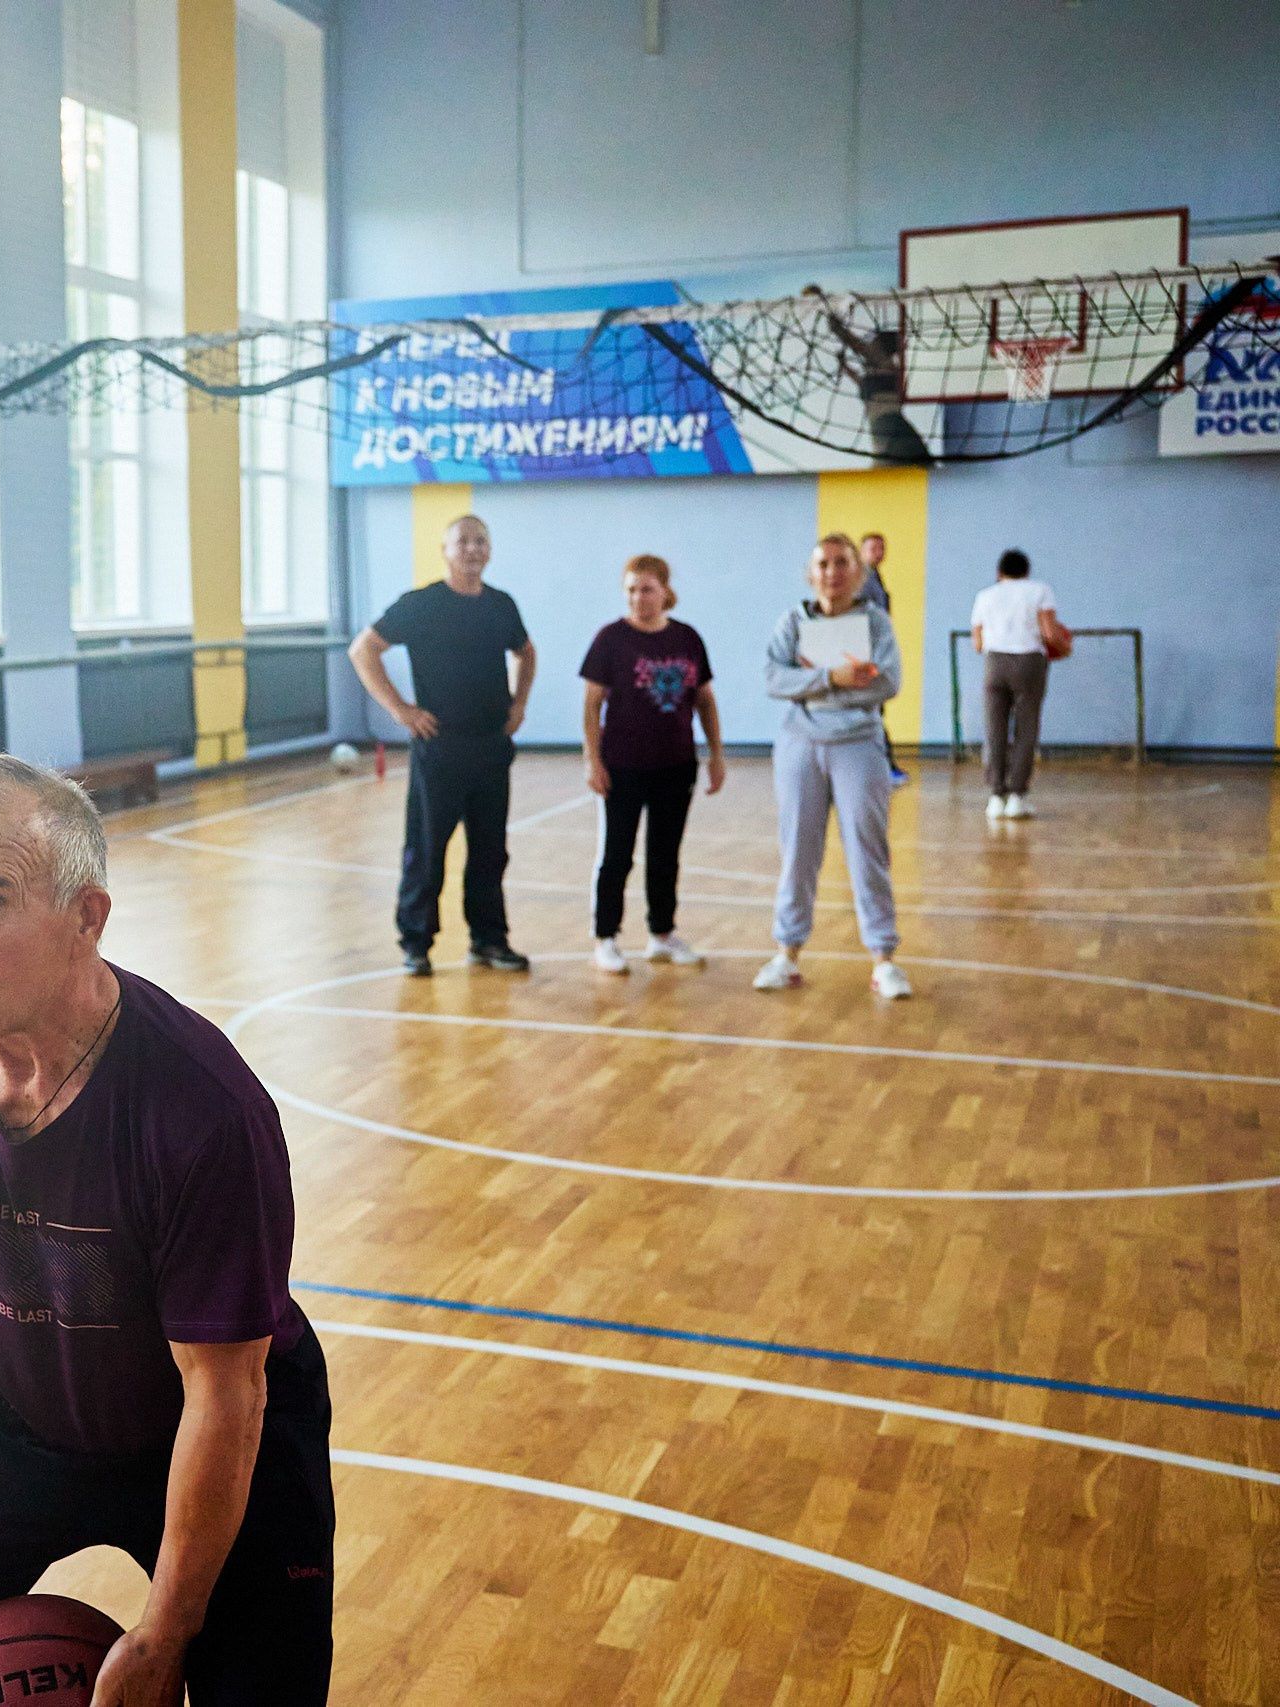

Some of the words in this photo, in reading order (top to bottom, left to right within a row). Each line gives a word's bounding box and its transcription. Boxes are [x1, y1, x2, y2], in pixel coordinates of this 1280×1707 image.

[354, 377, 391, 415] К
[391, 367, 555, 412] НОВЫМ
[352, 414, 709, 470] ДОСТИЖЕНИЯМ!
[17, 1309, 54, 1323] LAST
